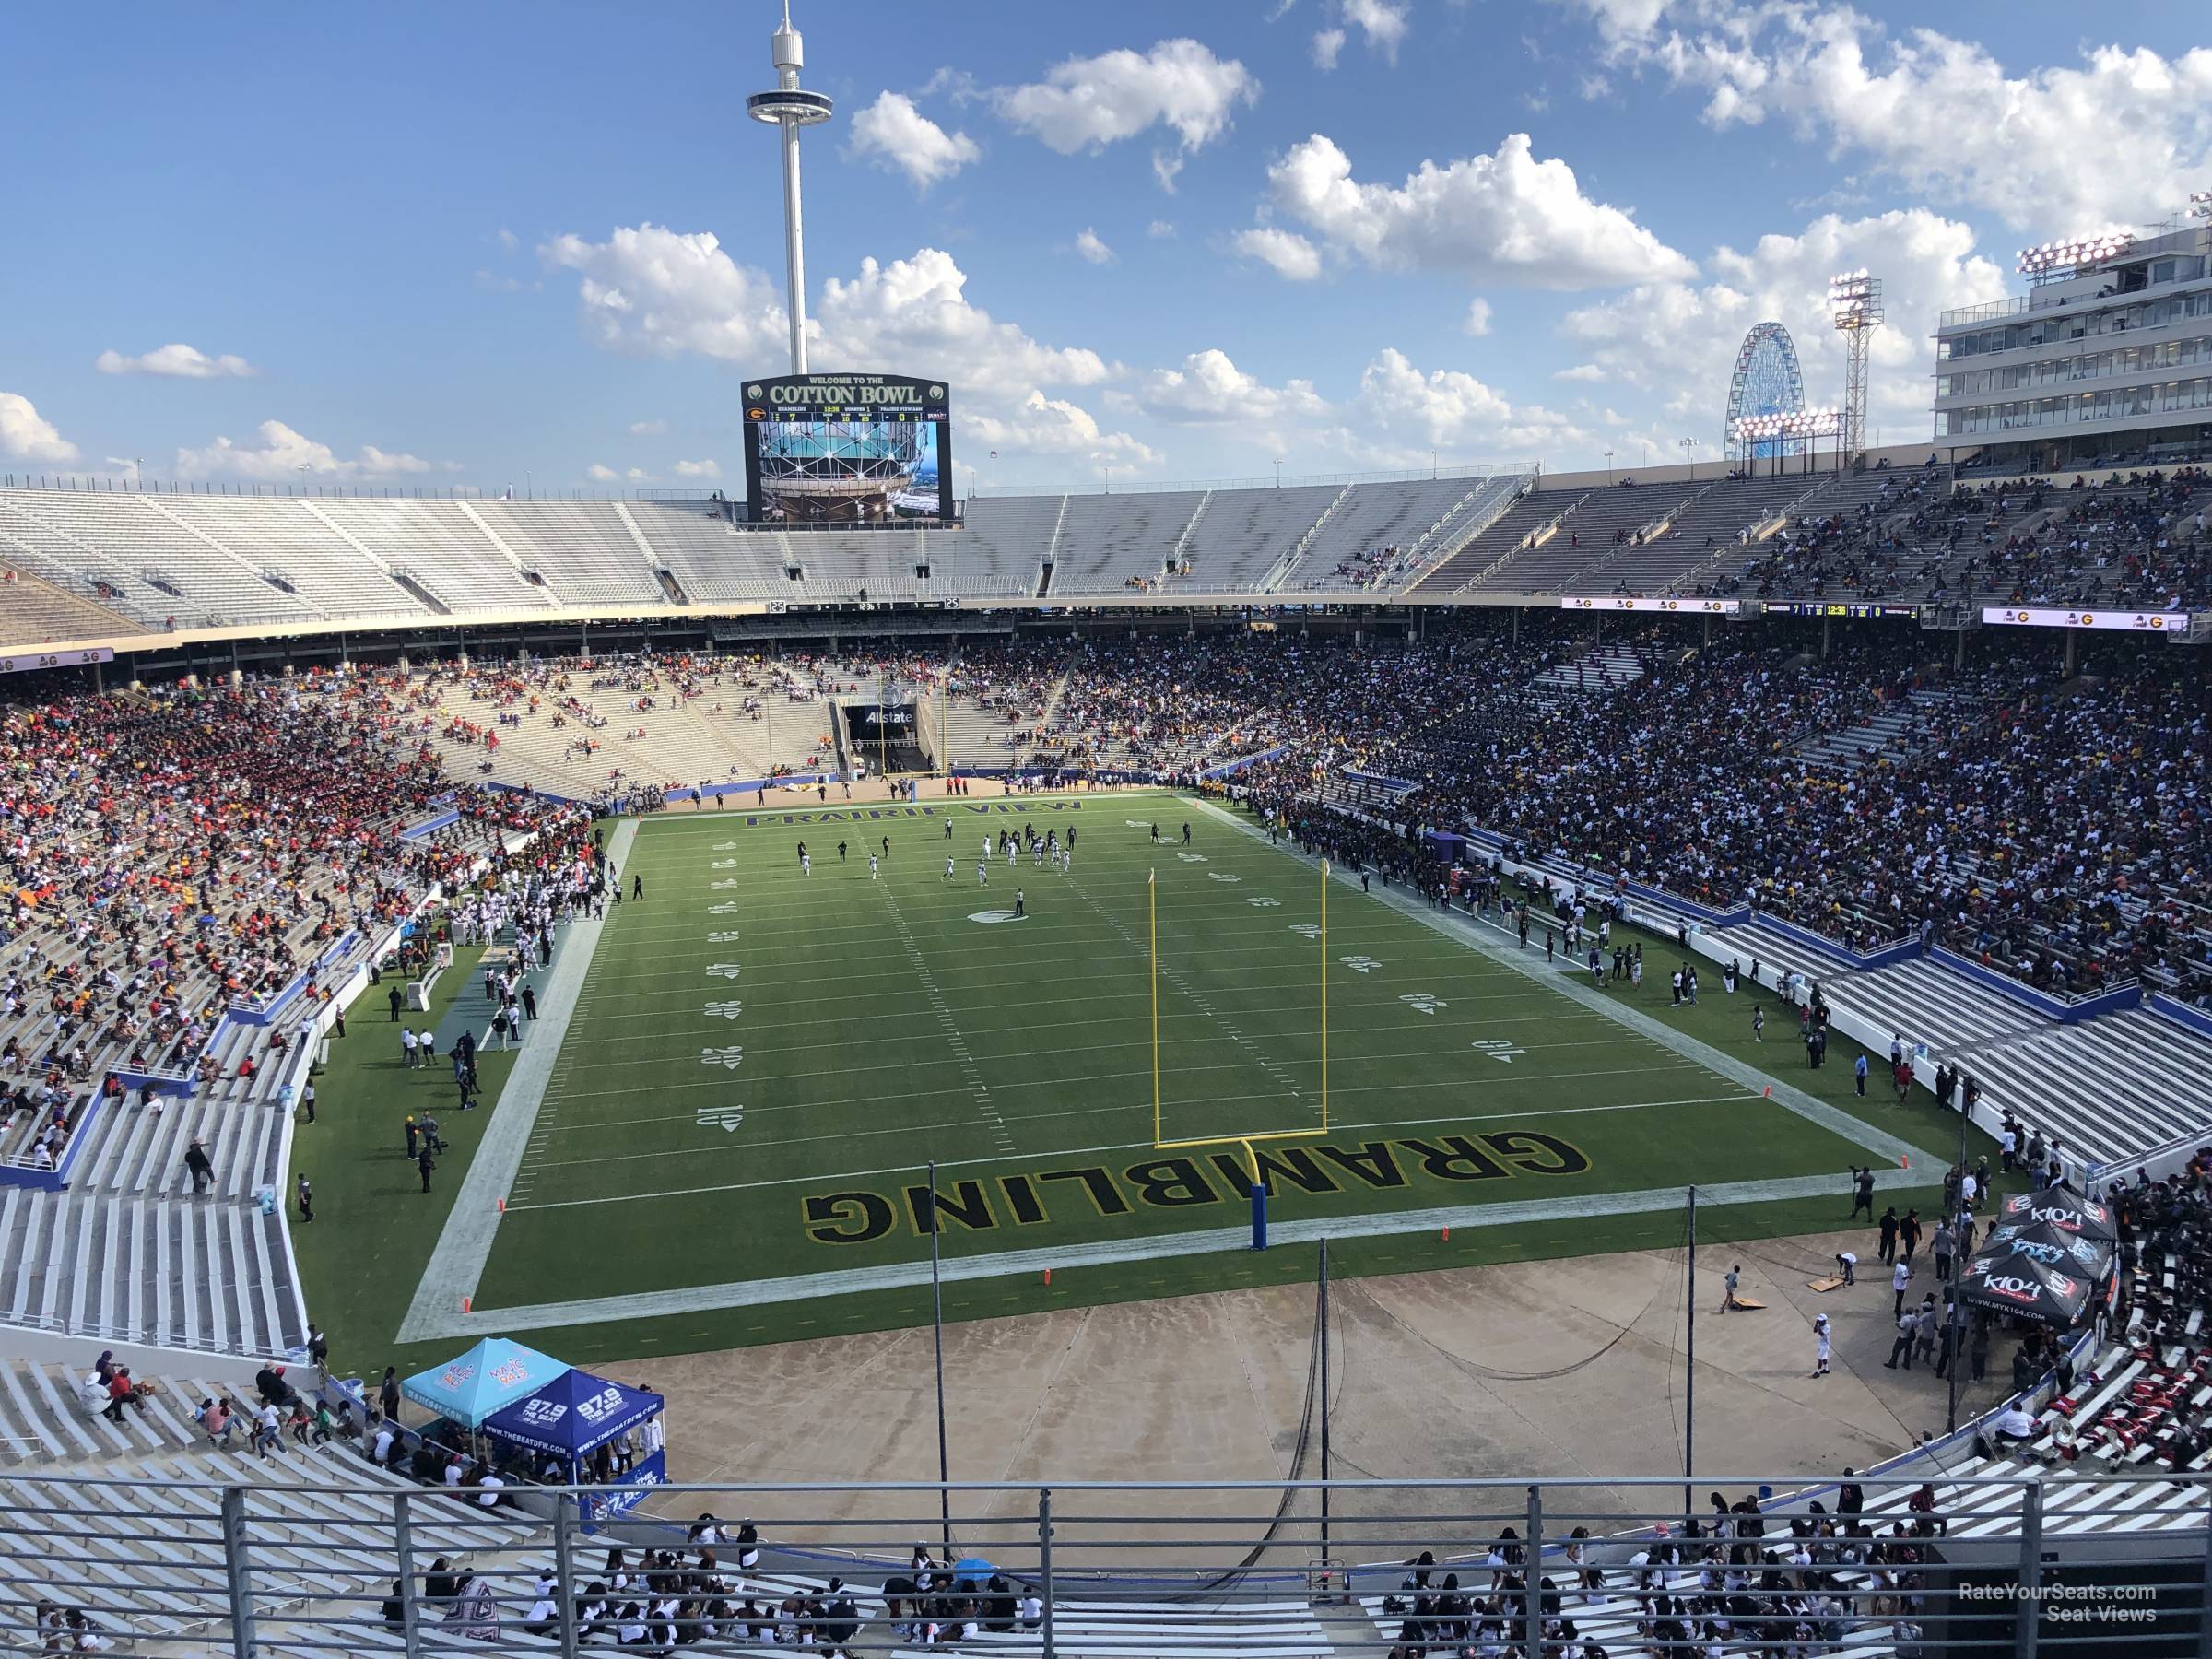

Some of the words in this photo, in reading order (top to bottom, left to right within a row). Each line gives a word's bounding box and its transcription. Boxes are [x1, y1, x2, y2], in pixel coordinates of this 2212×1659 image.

[769, 385, 855, 404] COTTON
[859, 385, 923, 404] BOWL
[789, 413, 796, 422] 7
[899, 414, 905, 422] 0
[771, 602, 783, 612] 25
[946, 599, 959, 608] 25
[1794, 605, 1799, 614] 7
[1875, 606, 1881, 617] 0
[866, 712, 912, 723] Alstate
[745, 806, 952, 827] PRAIRIE
[962, 801, 1086, 815] VIEW
[1337, 956, 1382, 970] 30
[704, 1000, 743, 1016] 30
[1398, 994, 1451, 1010] 20
[700, 1045, 743, 1065] 20
[1471, 1040, 1527, 1055] 10
[696, 1104, 744, 1125] 10
[801, 1130, 1594, 1246] GRAMBLING
[2030, 1206, 2083, 1226] K104
[1983, 1274, 2041, 1298] K104
[1967, 1296, 2045, 1321] WWW.MYK104.COM
[488, 1358, 525, 1379] MAJIC
[498, 1370, 528, 1385] 94.5
[525, 1398, 568, 1418] 97.9
[576, 1387, 621, 1417] 97.9
[585, 1408, 604, 1421] THE
[604, 1396, 624, 1411] BEAT
[522, 1409, 537, 1418] THE
[537, 1414, 559, 1423] BEAT
[577, 1403, 658, 1453] WWW.THEBEATDFW.COM
[485, 1425, 567, 1455] WWW.THEBEATDFW.COM
